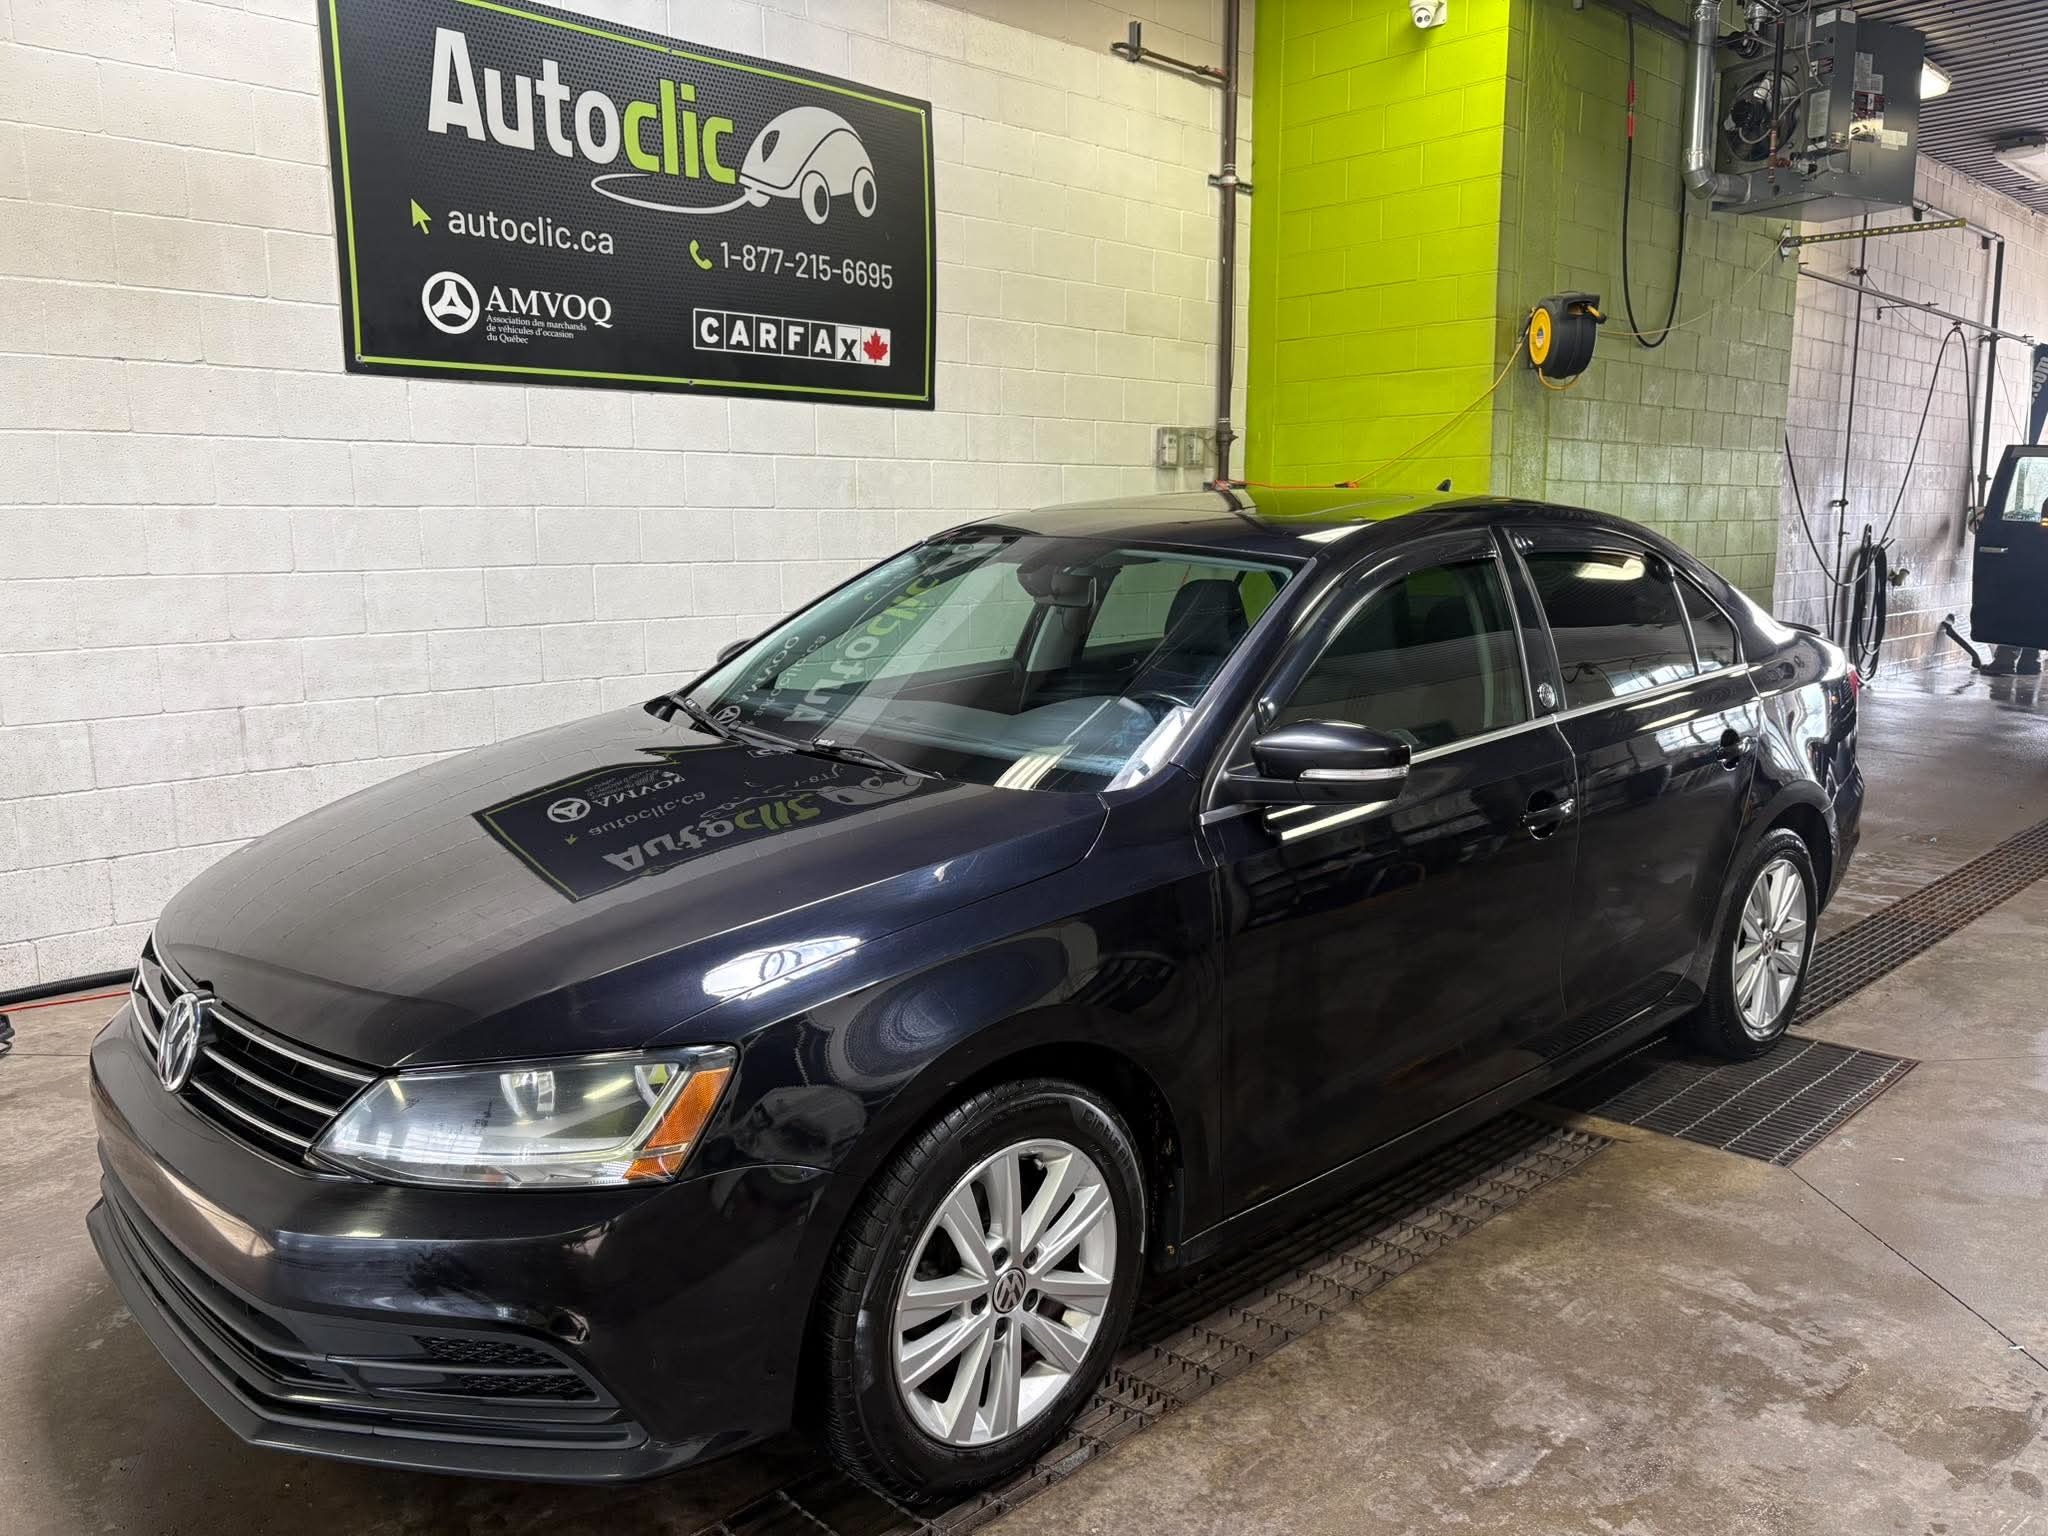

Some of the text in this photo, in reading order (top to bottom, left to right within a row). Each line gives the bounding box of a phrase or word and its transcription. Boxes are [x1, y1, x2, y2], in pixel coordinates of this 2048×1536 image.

[427, 26, 737, 185] Autoclic
[447, 210, 615, 255] autoclic.ca
[719, 241, 893, 290] 1-877-215-6695
[484, 285, 614, 329] AMVOQ
[485, 314, 588, 332] Association des marchands
[486, 323, 575, 340] de véhicules d'occasion
[486, 333, 529, 345] du Québec
[700, 316, 858, 362] CARFAX
